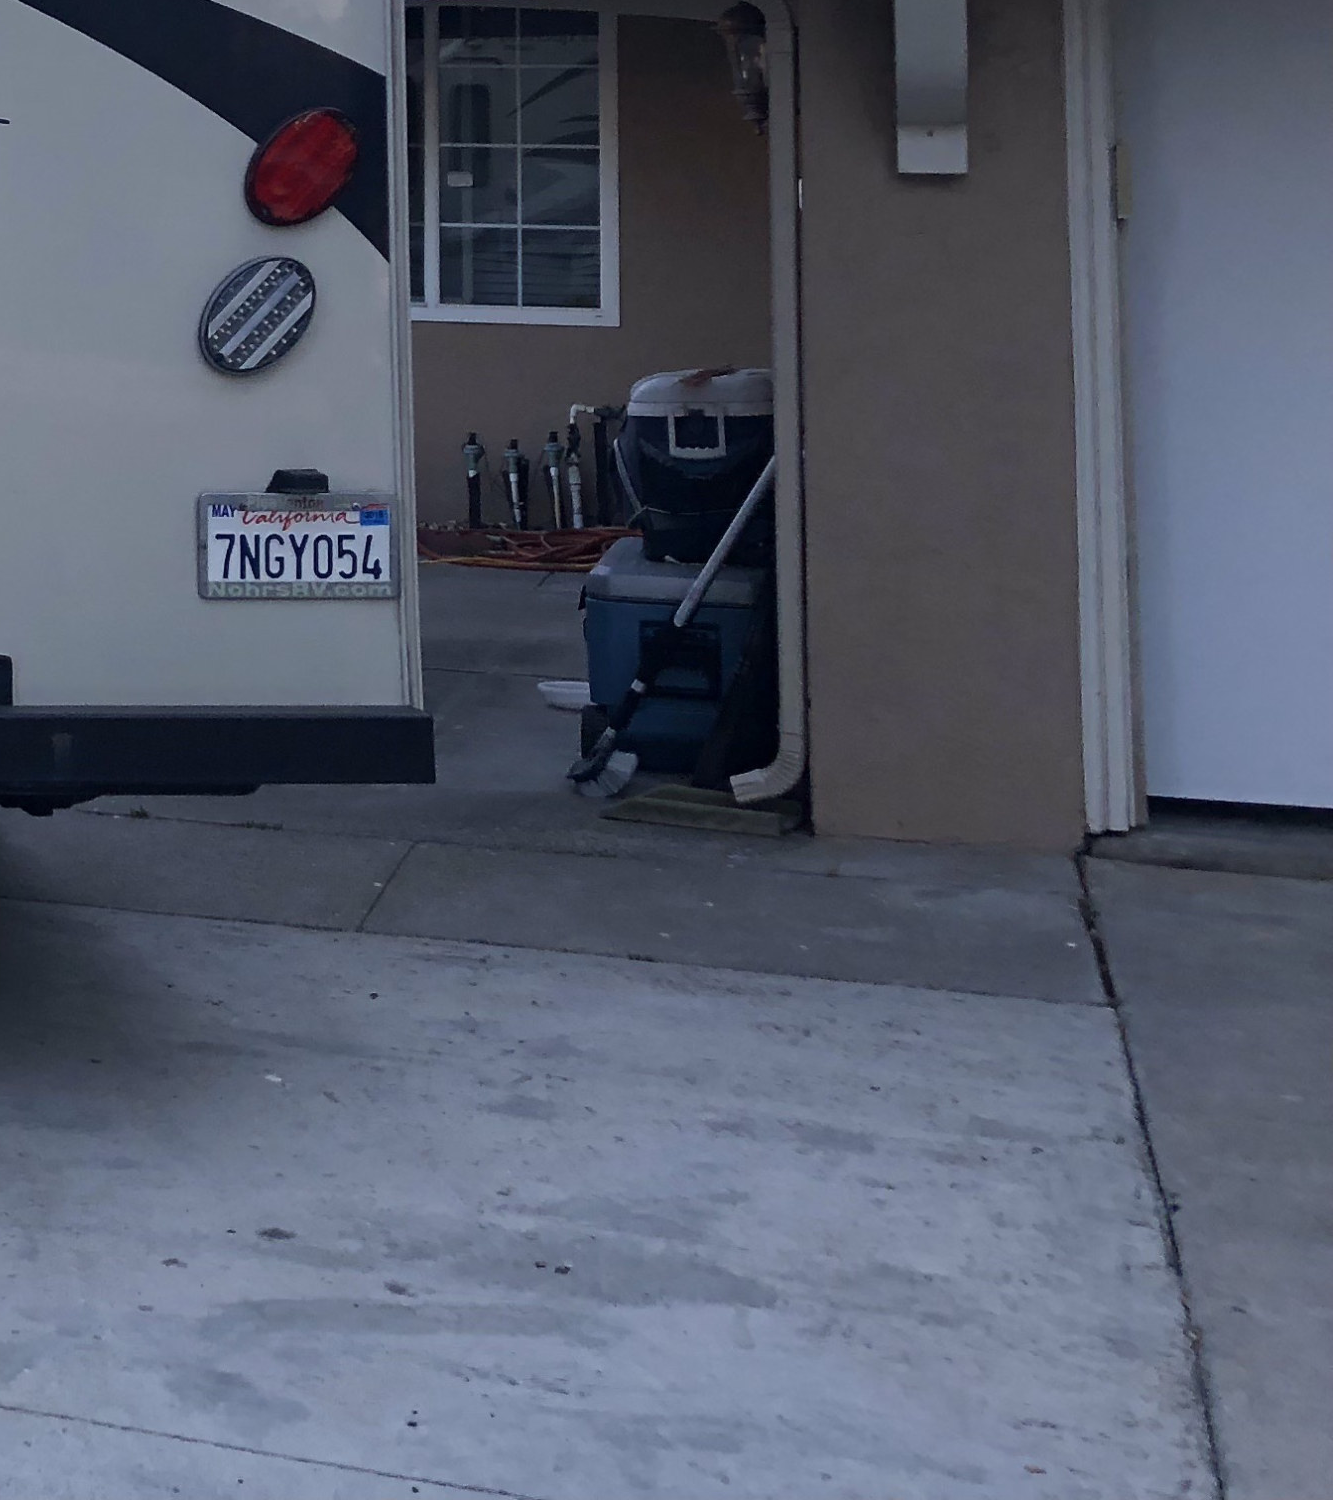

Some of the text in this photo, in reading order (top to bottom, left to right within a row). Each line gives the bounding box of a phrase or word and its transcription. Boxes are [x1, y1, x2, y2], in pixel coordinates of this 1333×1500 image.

[211, 504, 236, 518] MAY
[242, 509, 359, 532] California
[214, 533, 384, 580] 7NGY054
